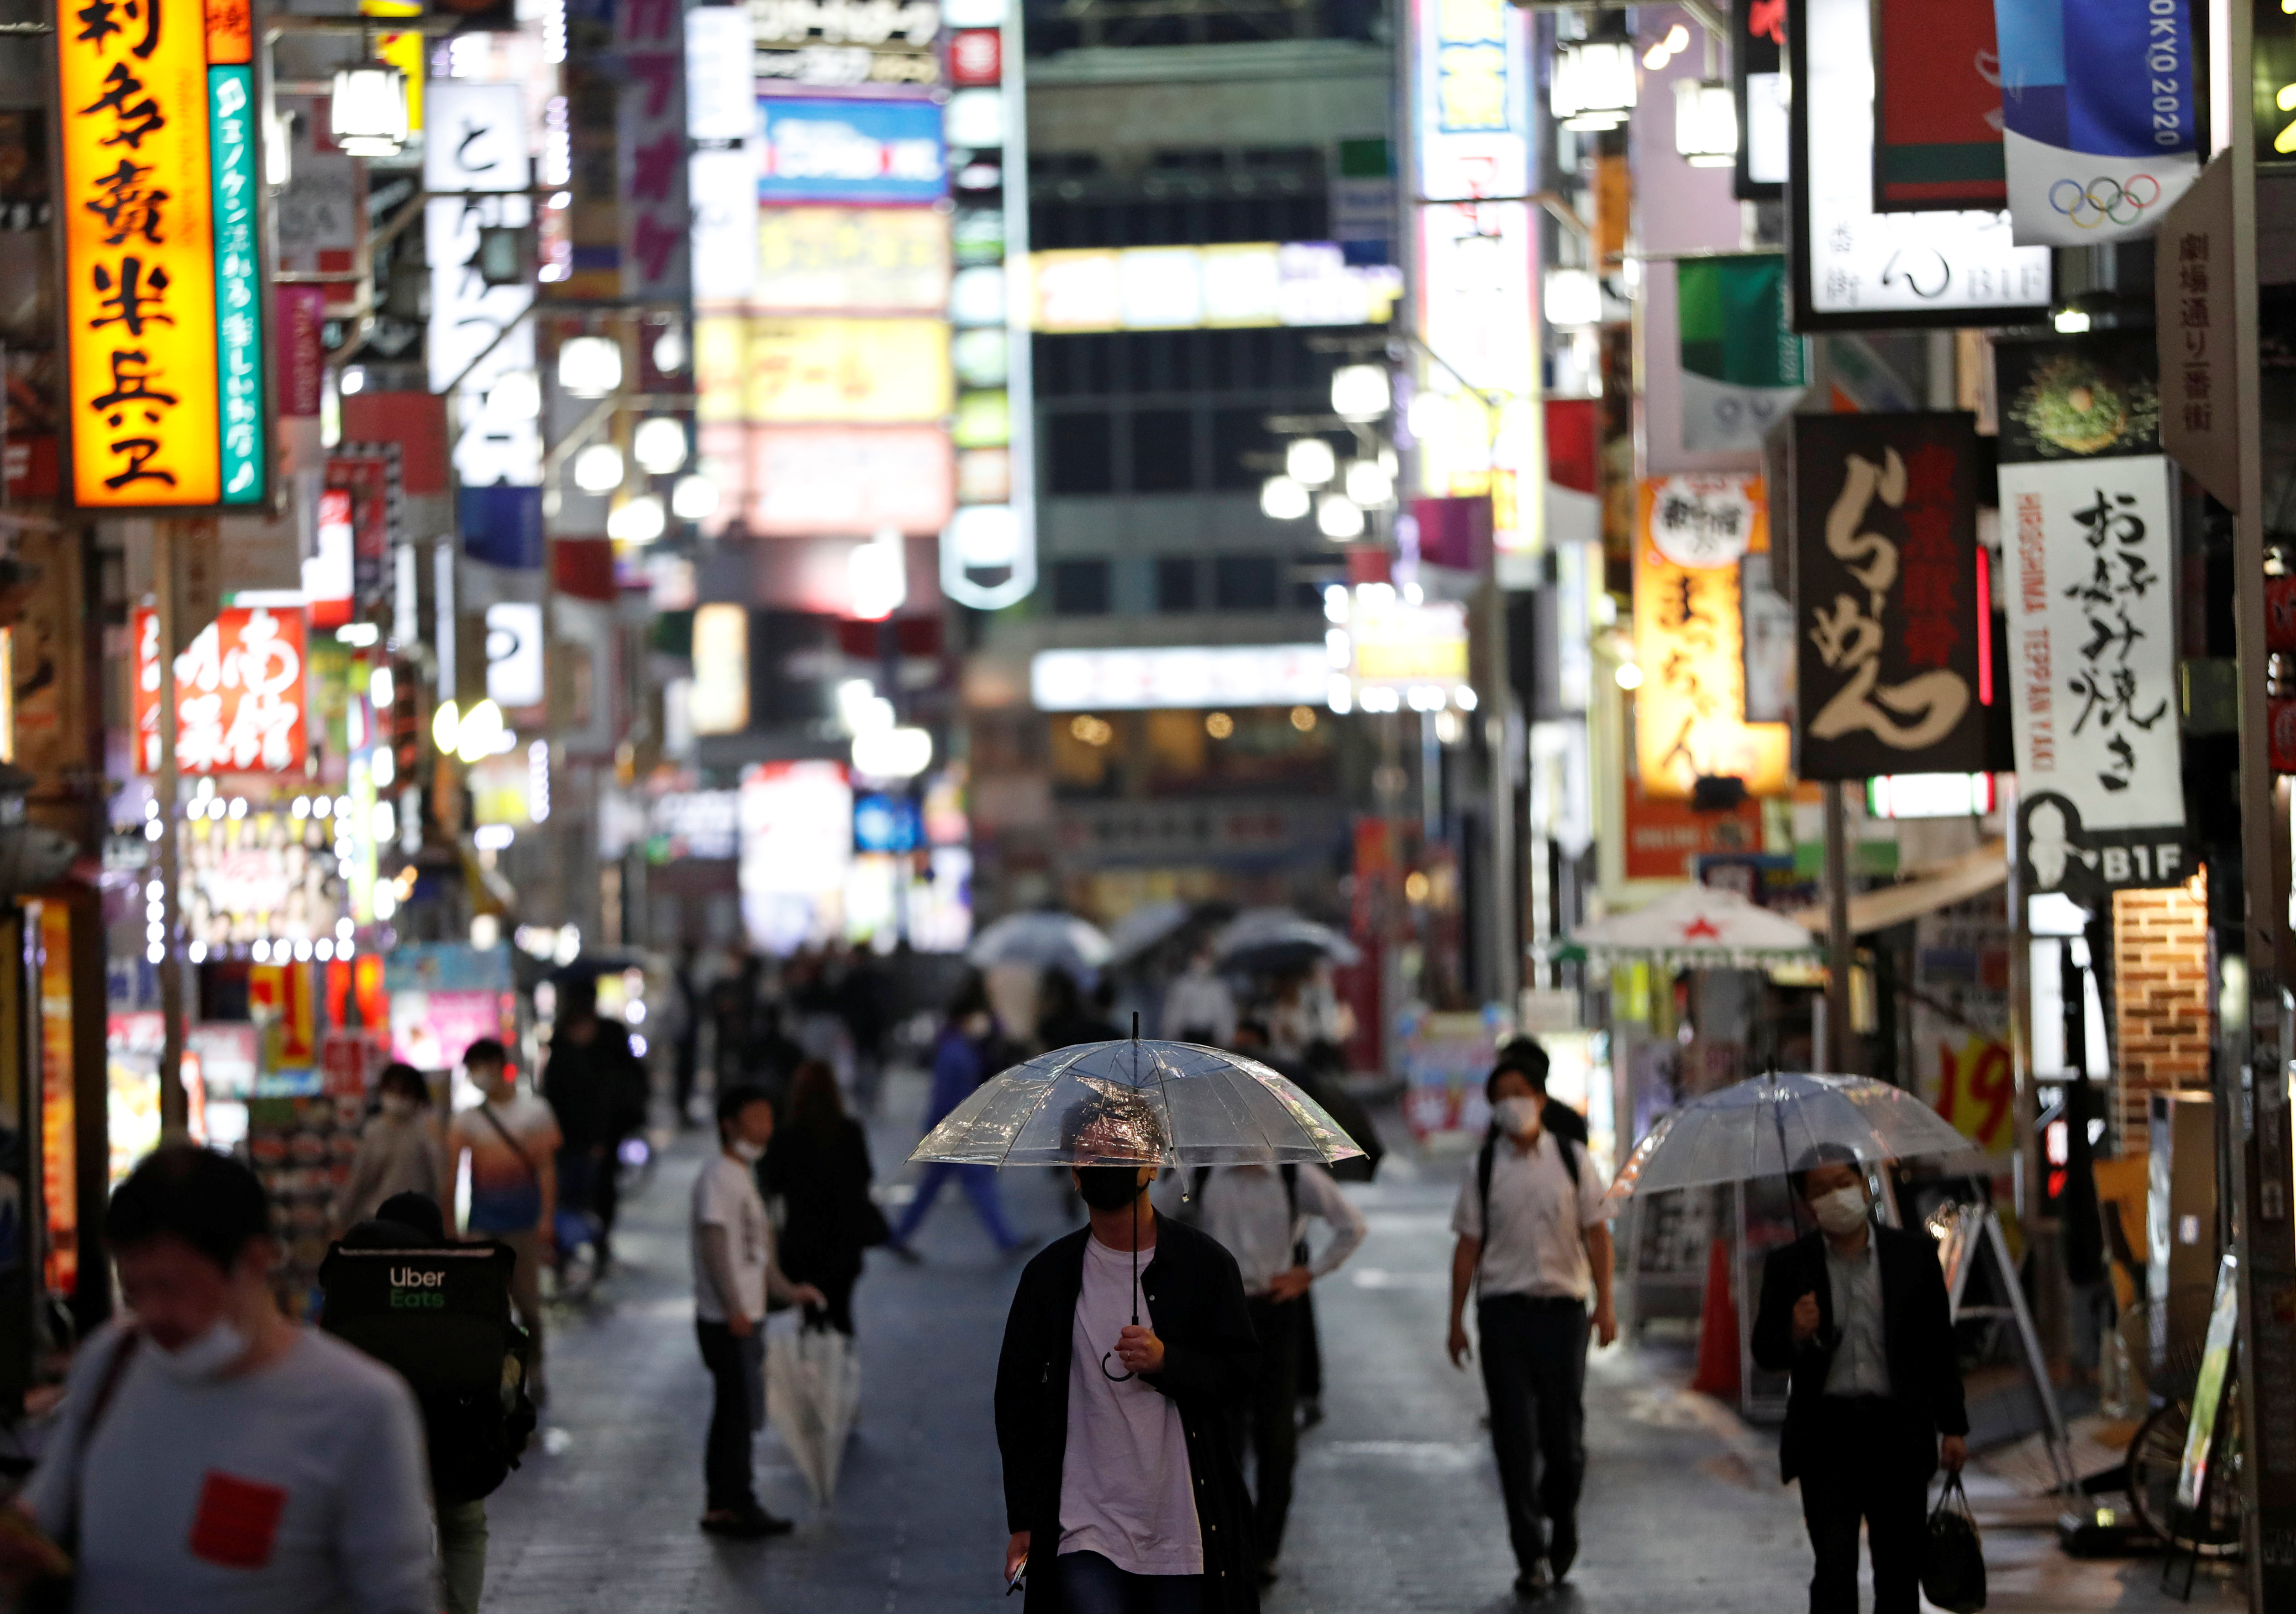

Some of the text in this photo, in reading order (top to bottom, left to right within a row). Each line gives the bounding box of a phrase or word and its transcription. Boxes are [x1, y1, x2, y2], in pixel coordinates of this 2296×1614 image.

[2152, 78, 2180, 146] 2020
[2015, 492, 2047, 613] HIROSHIMA
[2023, 628, 2052, 714] TEPPAN
[2062, 488, 2167, 792] お好み焼き
[2102, 844, 2182, 882] B1F
[390, 1267, 446, 1287] Uber
[390, 1288, 444, 1307] Eats
